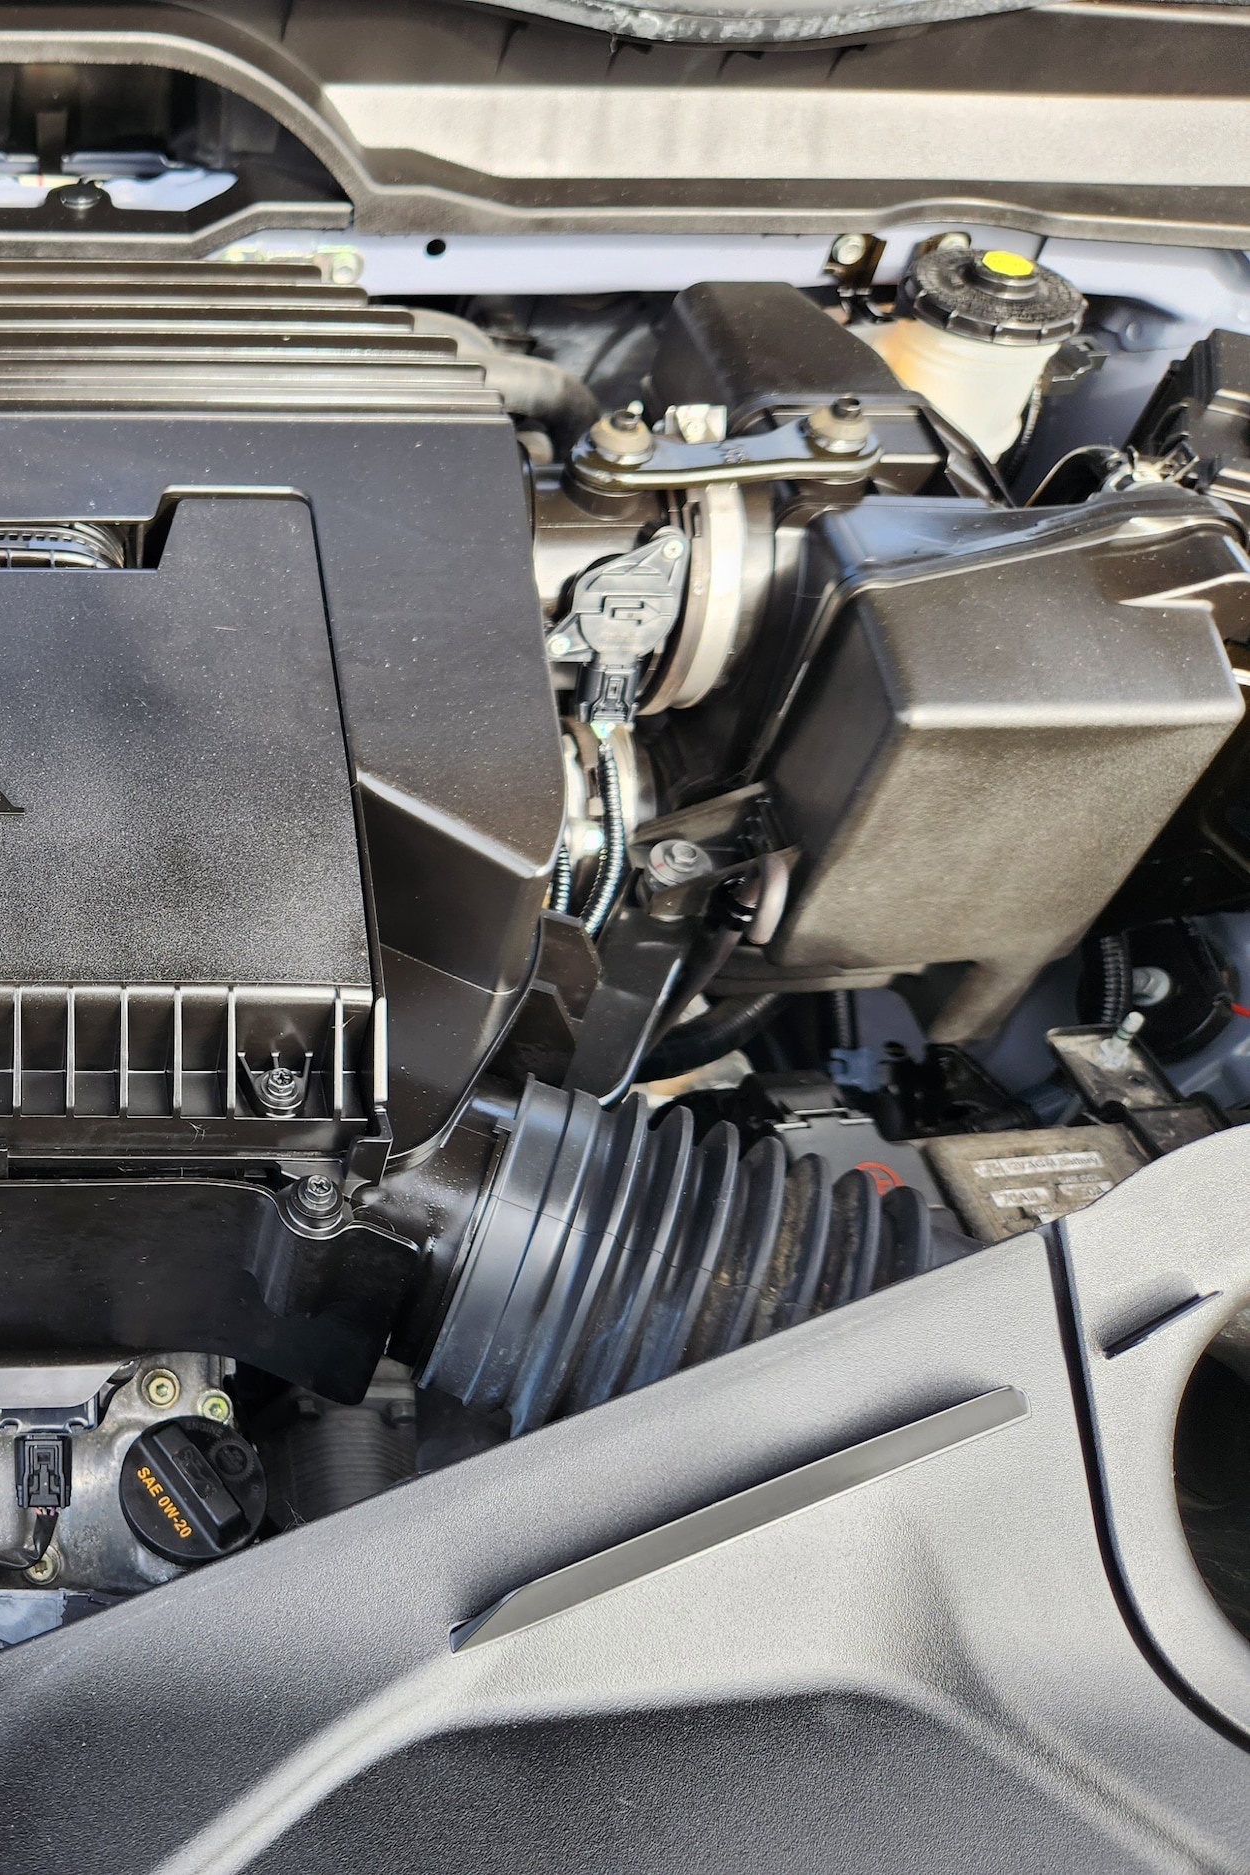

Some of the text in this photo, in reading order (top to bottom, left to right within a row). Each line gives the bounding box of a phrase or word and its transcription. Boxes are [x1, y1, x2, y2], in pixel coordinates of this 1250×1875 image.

[1028, 1159, 1058, 1170] AGM
[185, 1421, 224, 1438] ENGINE
[136, 1466, 193, 1539] SAE 0W-20
